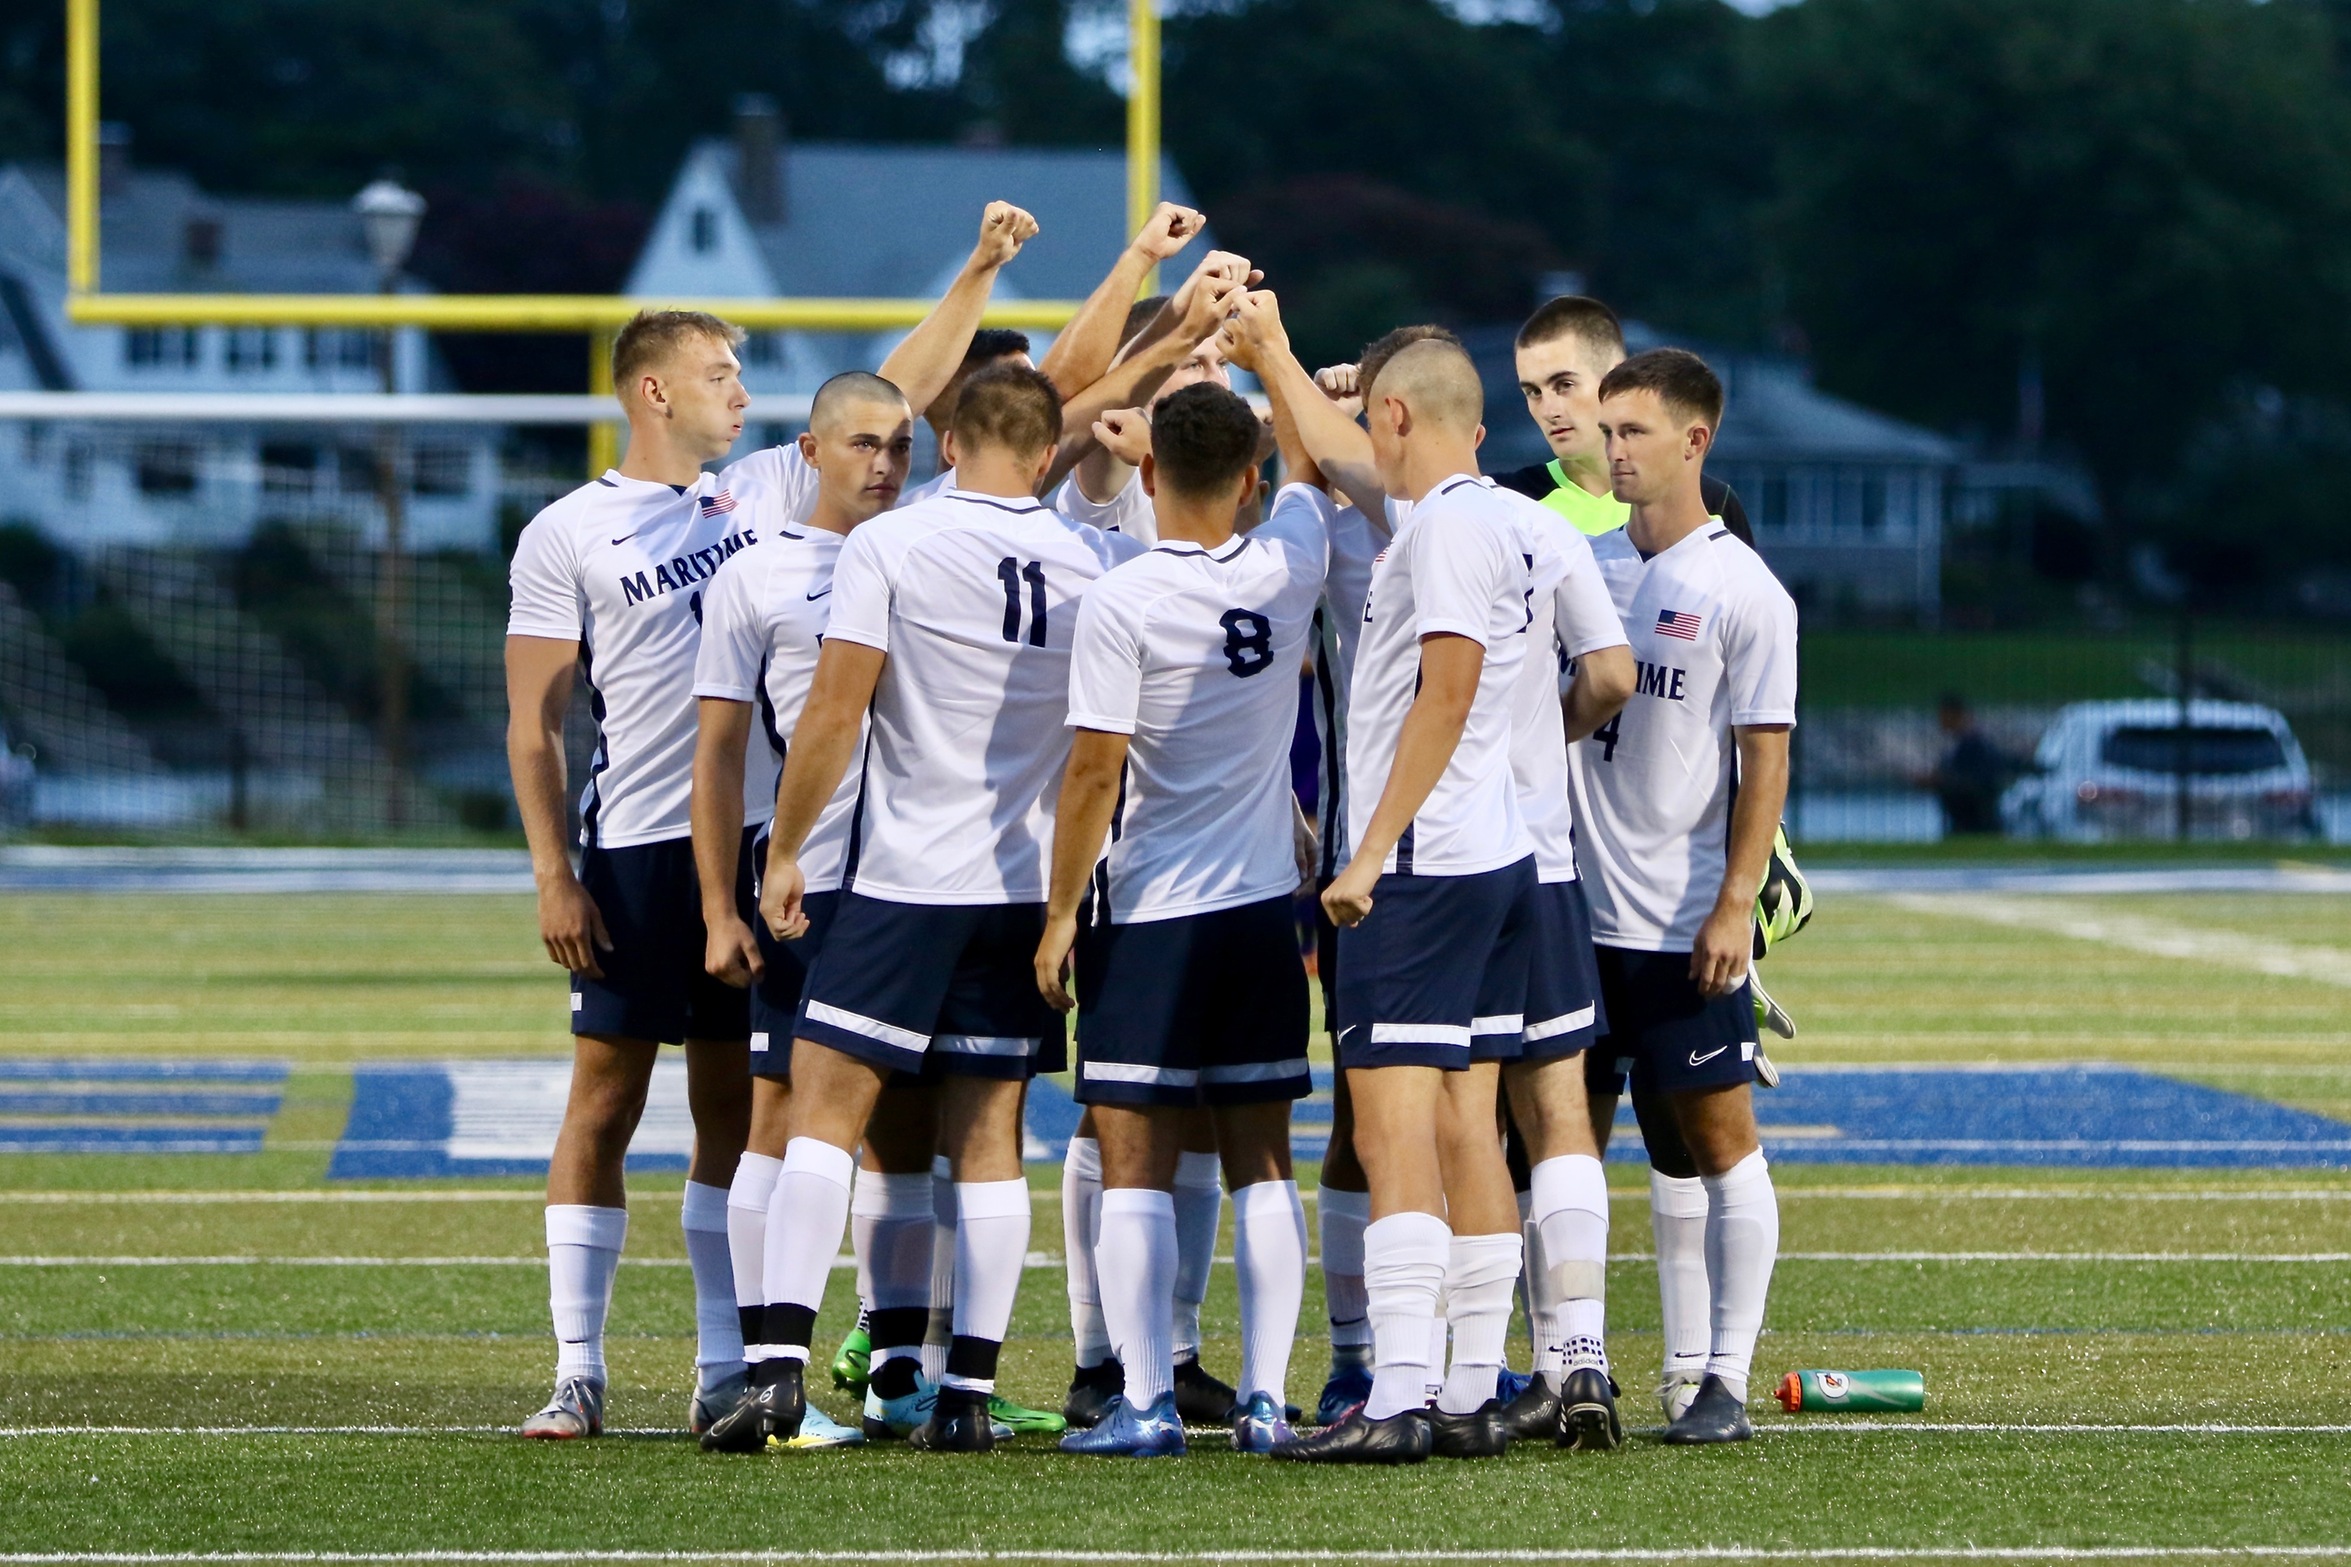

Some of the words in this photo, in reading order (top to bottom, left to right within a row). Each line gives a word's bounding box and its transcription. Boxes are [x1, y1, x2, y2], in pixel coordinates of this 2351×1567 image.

[620, 528, 758, 607] MARITIME
[997, 557, 1046, 647] 11
[1219, 607, 1274, 679] 8
